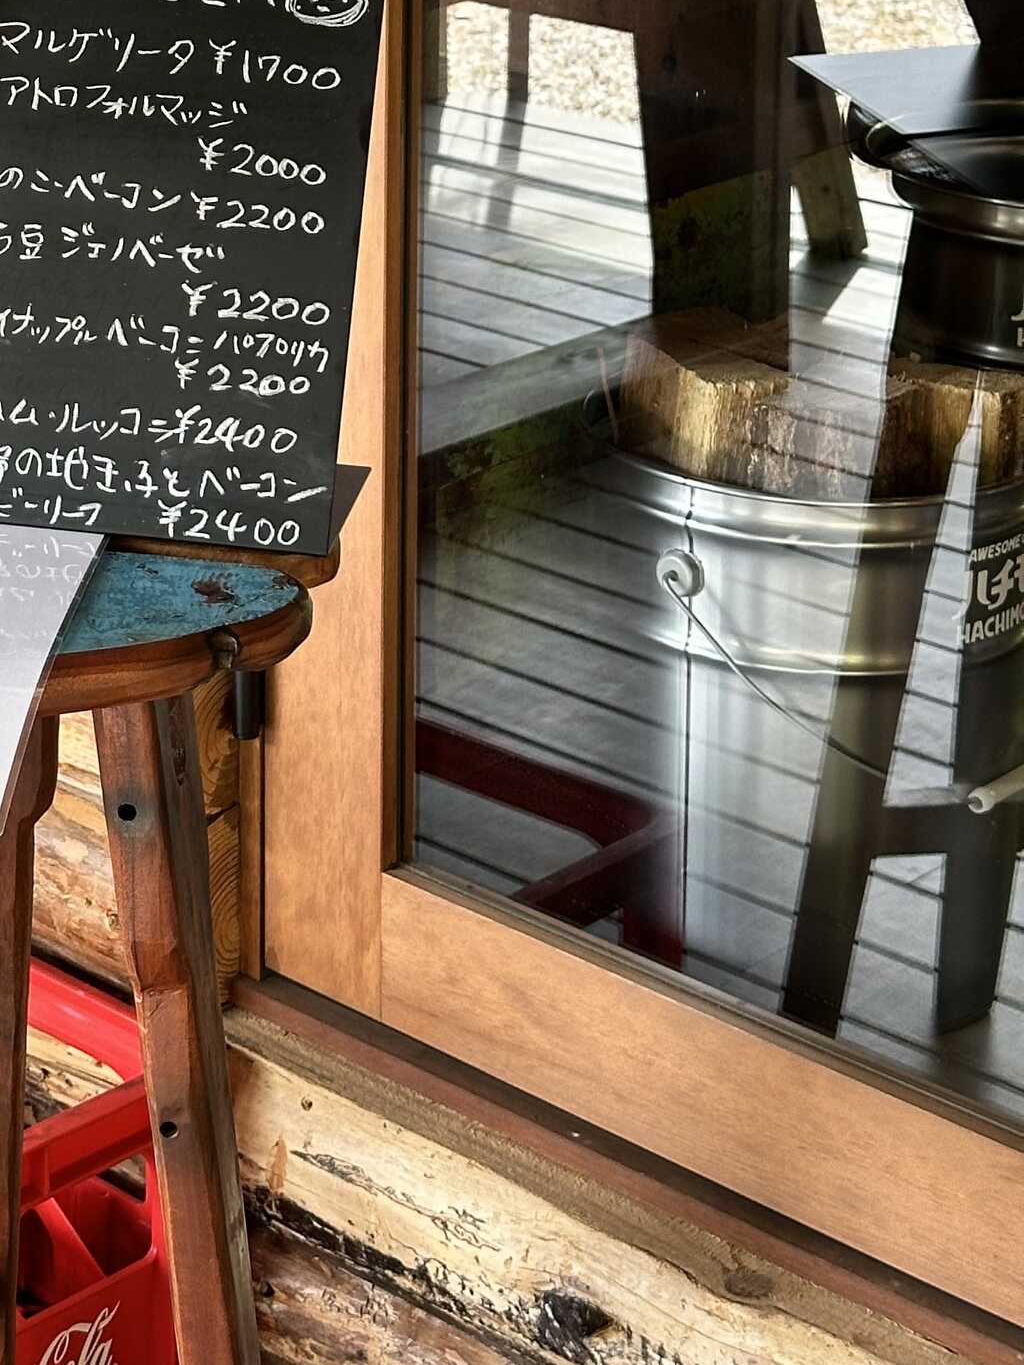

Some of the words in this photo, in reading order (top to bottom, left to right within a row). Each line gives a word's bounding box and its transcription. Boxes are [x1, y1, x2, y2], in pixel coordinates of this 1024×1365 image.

[208, 38, 341, 90] ¥1700
[197, 135, 328, 186] ¥2000
[189, 190, 326, 235] ¥2200
[181, 279, 331, 326] ¥2200
[173, 357, 311, 398] ¥2200
[174, 404, 298, 455] ¥2400
[157, 498, 301, 546] ¥2400
[968, 533, 1021, 564] AWESOME
